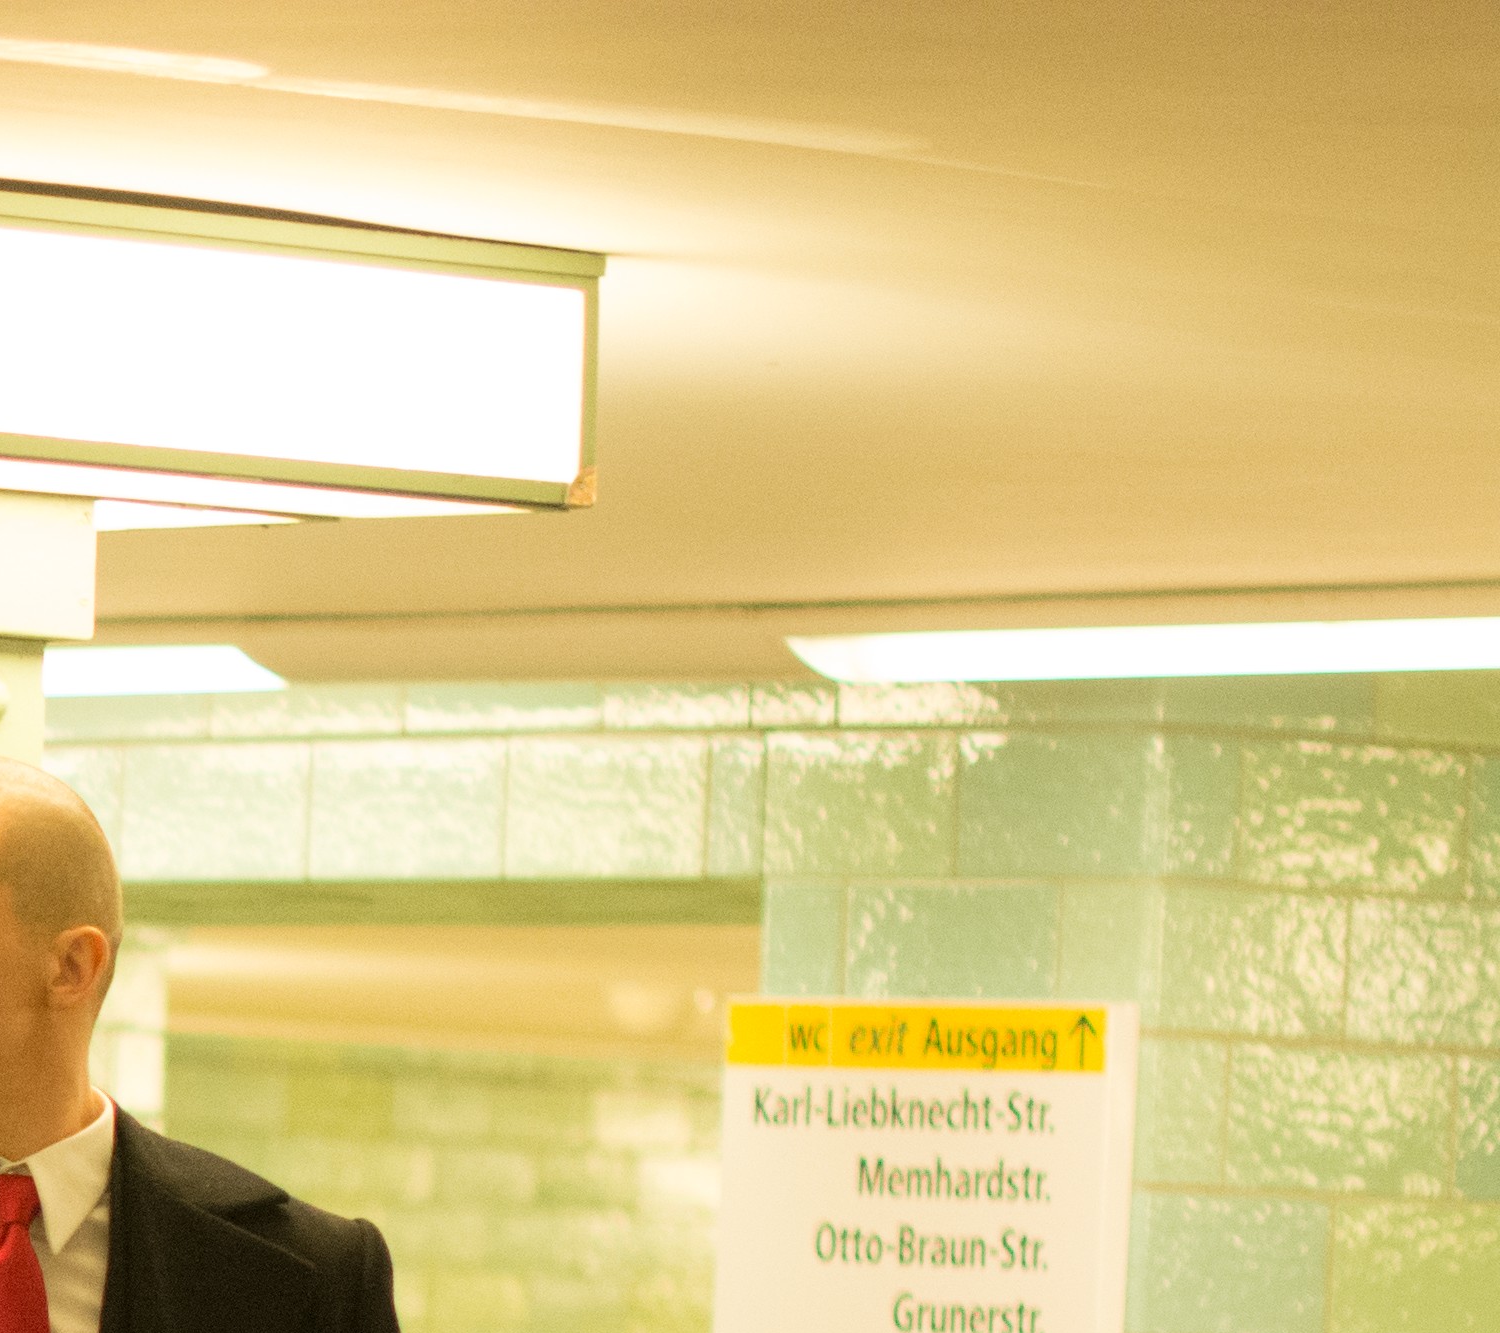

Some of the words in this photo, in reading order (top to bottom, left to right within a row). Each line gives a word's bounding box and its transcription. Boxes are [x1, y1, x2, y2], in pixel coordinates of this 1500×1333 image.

[850, 1015, 909, 1056] exit
[923, 1017, 1058, 1071] Ausgang
[753, 1086, 1055, 1134] Karl-Liebknecht-Str.
[856, 1157, 1051, 1201] Memhardstr.
[815, 1223, 1049, 1271] Otto-Braun-Str.
